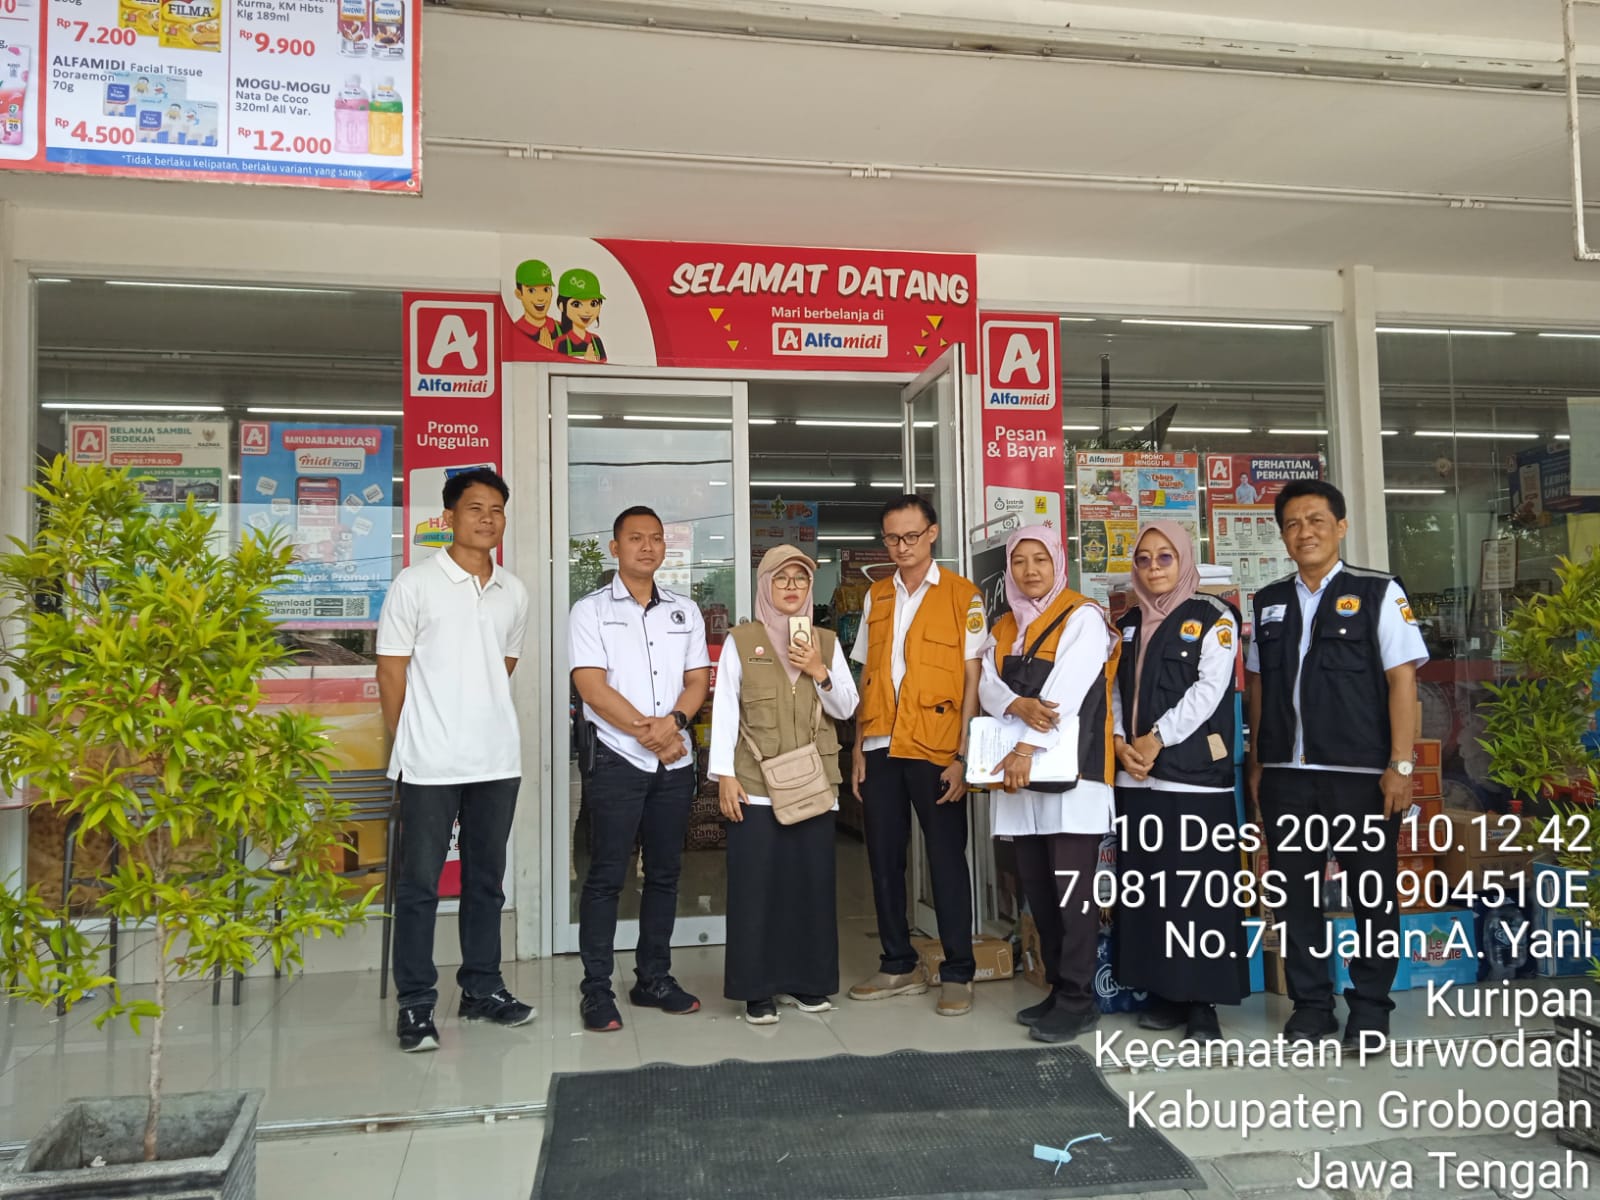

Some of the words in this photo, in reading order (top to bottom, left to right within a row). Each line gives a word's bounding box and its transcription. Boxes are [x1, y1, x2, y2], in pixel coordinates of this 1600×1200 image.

[167, 4, 213, 18] FILMA
[237, 0, 275, 12] Kurma,
[279, 1, 297, 11] KM
[299, 4, 324, 14] Hbts
[237, 11, 253, 21] Klg
[257, 11, 290, 22] 189ml
[57, 18, 71, 30] Rp
[73, 21, 137, 46] 7.200
[239, 29, 253, 41] Rp
[255, 32, 315, 57] 9.900
[53, 56, 126, 71] ALFAMIDI
[130, 63, 163, 74] Facial
[167, 66, 204, 78] Tissue
[53, 69, 116, 83] Doraemon
[53, 81, 74, 93] 70g
[236, 77, 331, 95] MOGU-MOGU
[236, 91, 261, 102] Nata
[265, 93, 279, 103] De
[282, 94, 309, 104] Coco
[235, 102, 270, 114] 320ml
[272, 104, 286, 114] All
[290, 106, 311, 116] Var.
[55, 117, 69, 129] Rp
[71, 121, 135, 145] 4.500
[238, 127, 252, 139] Rp
[253, 130, 332, 155] 12.000
[152, 156, 191, 167] berlaku
[193, 158, 240, 172] kelipatan,
[242, 161, 278, 173] berlaku
[279, 164, 313, 175] variant
[314, 167, 336, 179] yang
[338, 168, 362, 177] sama
[668, 262, 829, 297] SELAMAT
[836, 265, 970, 306] DATANG
[771, 306, 801, 319] Mari
[804, 308, 870, 323] berbelanja
[873, 309, 884, 321] di
[805, 331, 882, 350] Alfamidi
[417, 378, 488, 393] Alfamidi
[990, 392, 1051, 406] Alfamidi
[110, 427, 154, 436] BELANJA
[156, 427, 193, 436] SAMBIL
[427, 420, 479, 434] Promo
[995, 425, 1047, 442] Pesan
[110, 435, 155, 443] SEDEKAH
[326, 436, 377, 448] APLIKASI
[417, 434, 489, 450] Unggulan
[986, 441, 1001, 458] &
[1007, 442, 1056, 462] Bayar
[299, 453, 332, 466] midi
[1089, 455, 1122, 464] Alfamidi
[1252, 460, 1314, 471] PERHATIAN,
[1256, 470, 1319, 481] PERHATIAN!
[331, 573, 370, 582] Promo
[263, 599, 312, 608] Download
[692, 802, 720, 816] Tang
[1429, 938, 1443, 950] Le
